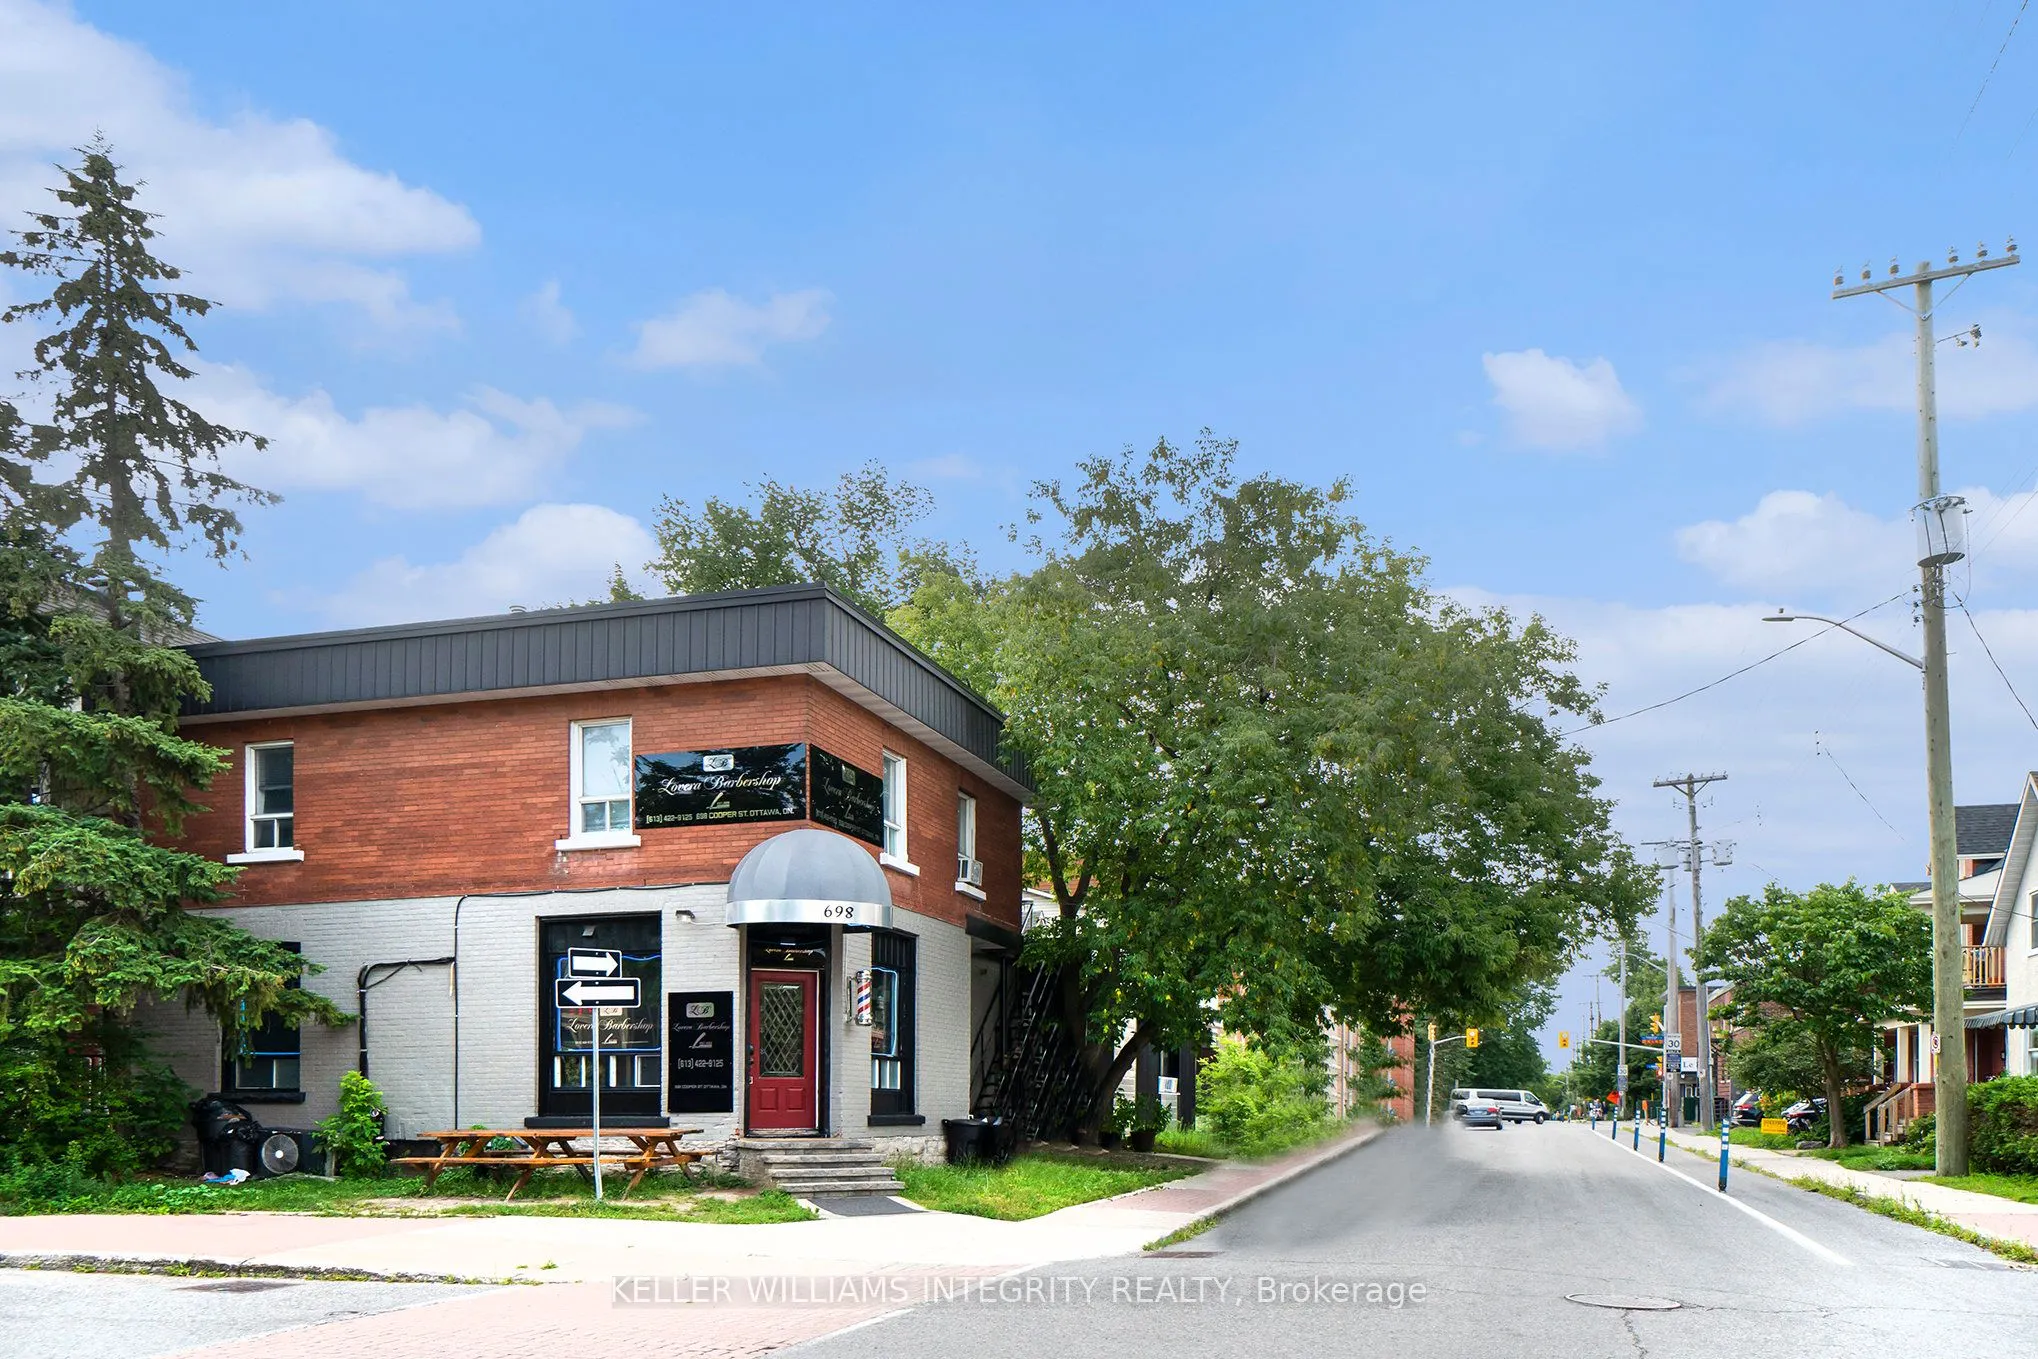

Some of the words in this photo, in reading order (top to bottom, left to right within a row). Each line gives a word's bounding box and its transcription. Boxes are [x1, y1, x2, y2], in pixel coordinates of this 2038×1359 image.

[658, 777, 702, 796] Lovera
[703, 770, 781, 791] Barbershop
[708, 810, 737, 819] COOPER
[749, 808, 782, 817] OTTAWA,
[824, 905, 854, 919] 698
[567, 1018, 594, 1033] Lover
[600, 1018, 654, 1034] Barbershop
[1667, 1040, 1680, 1048] 30
